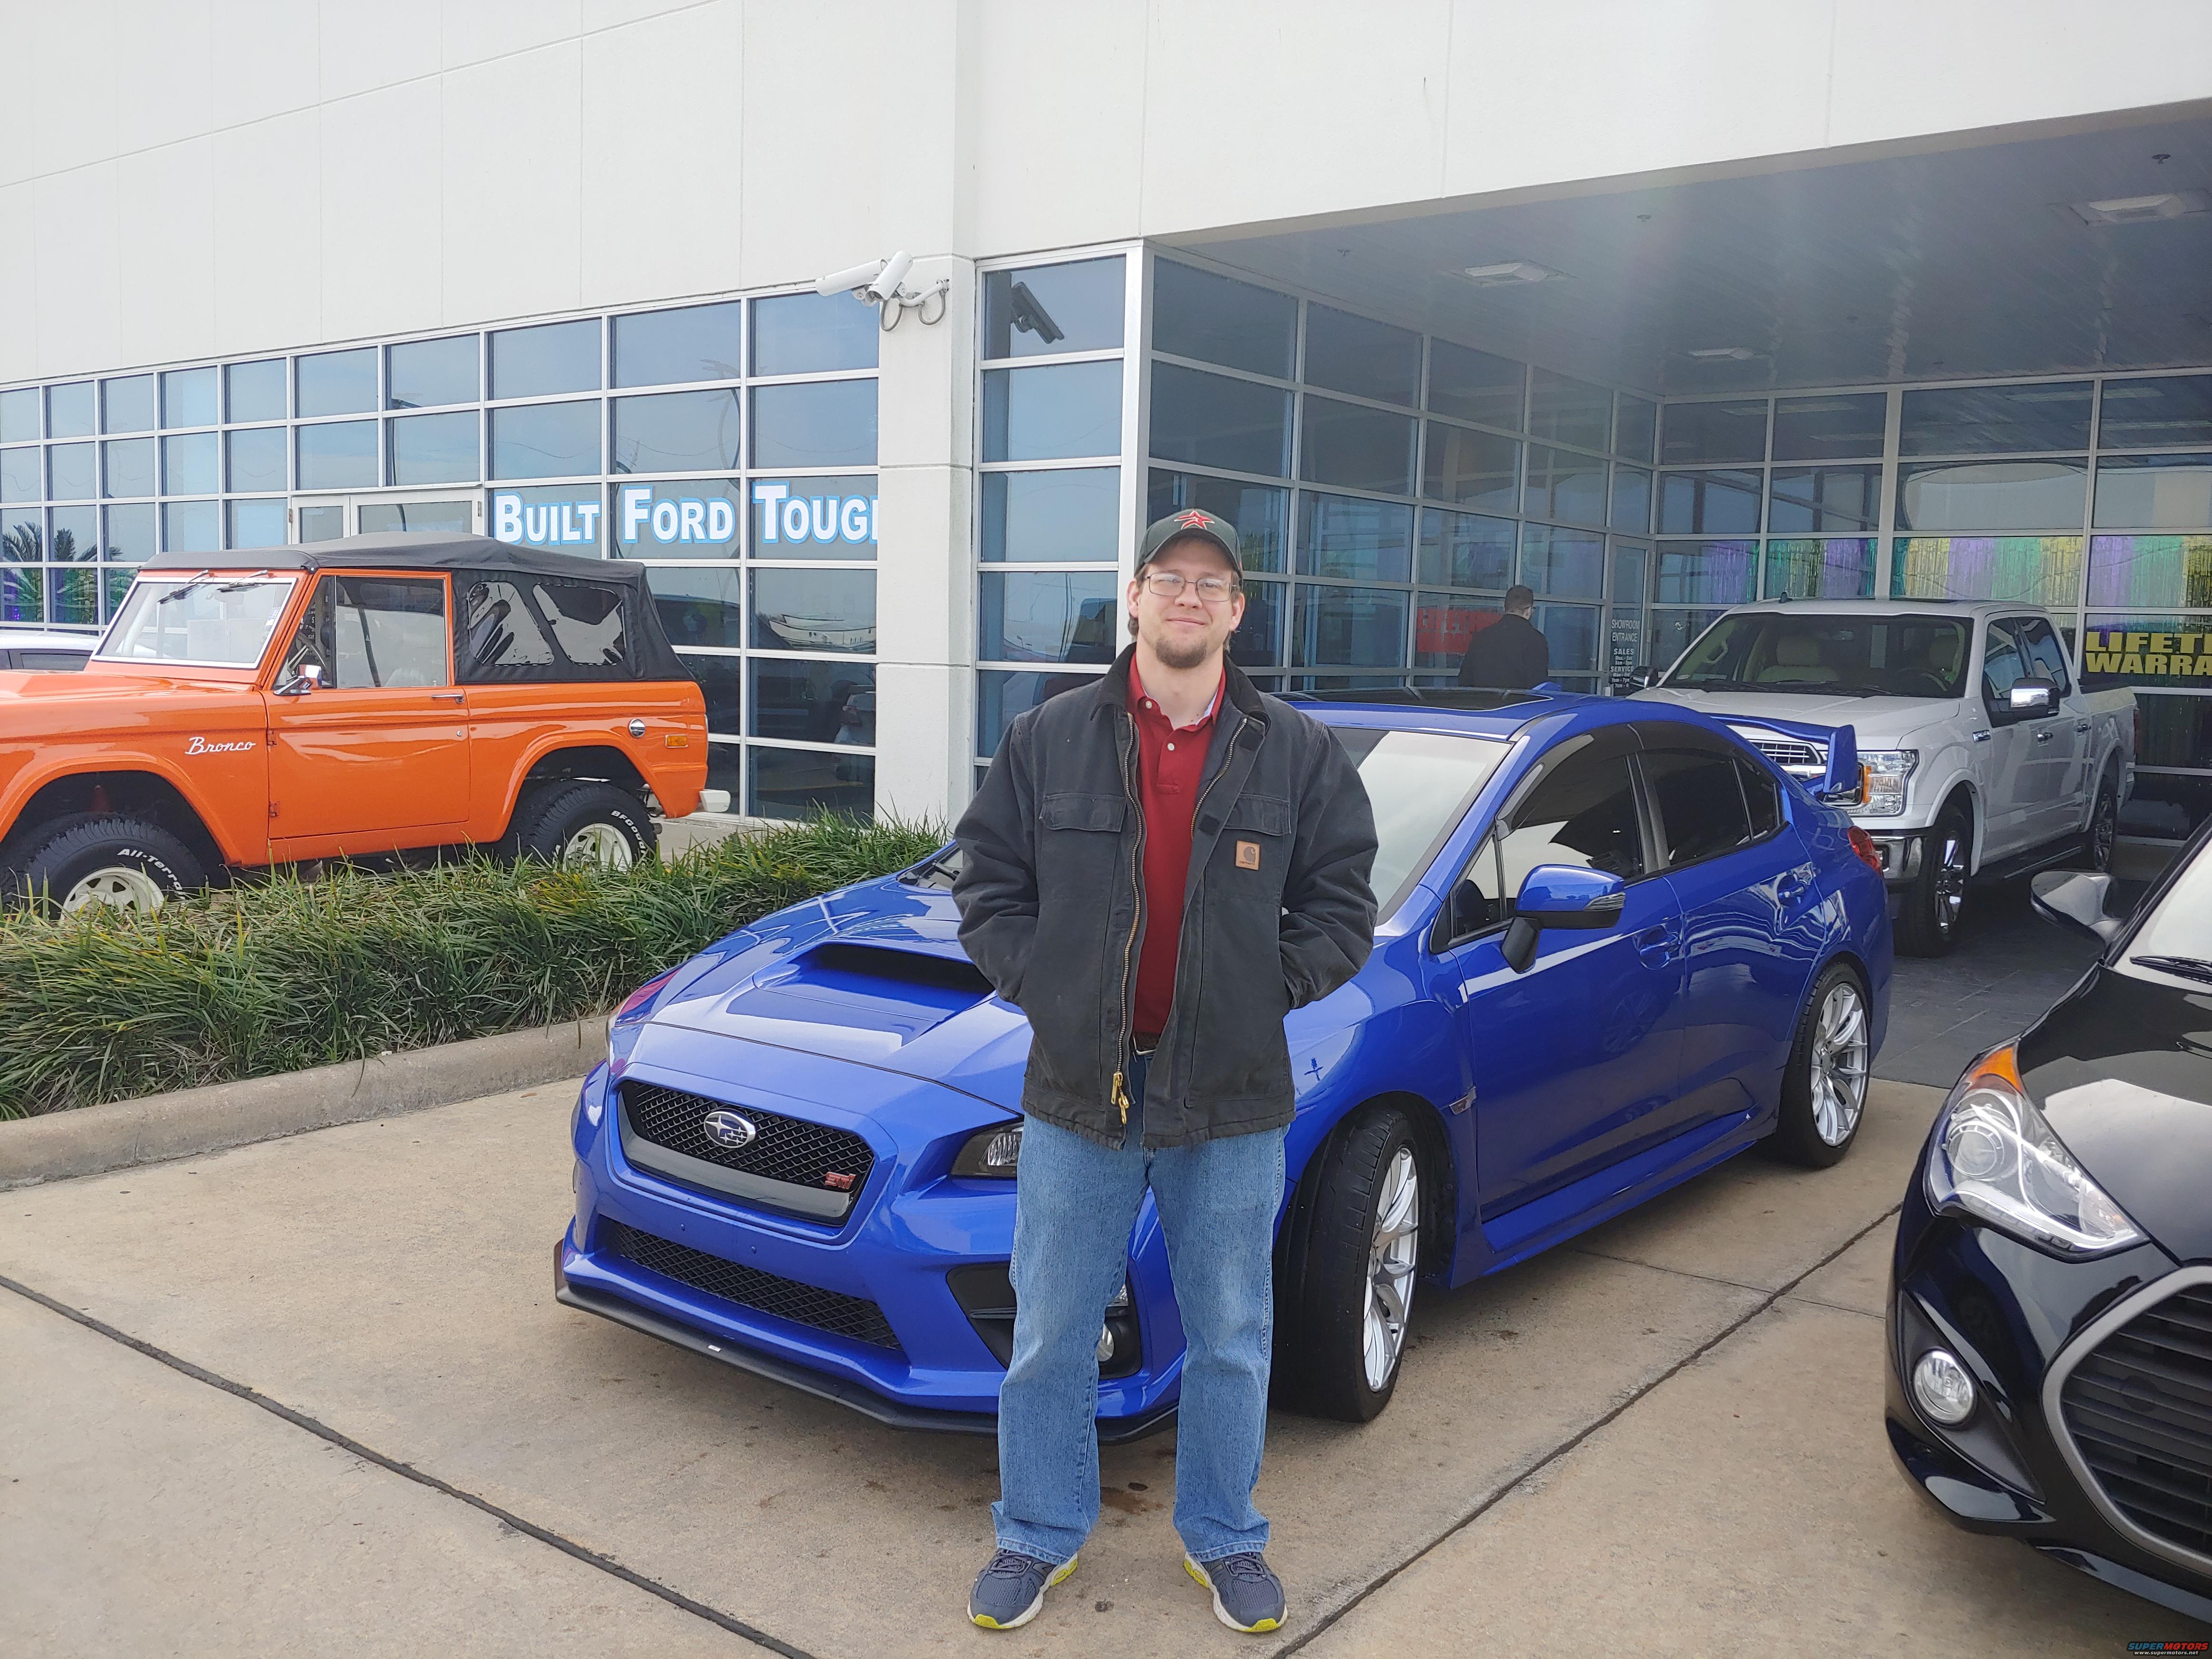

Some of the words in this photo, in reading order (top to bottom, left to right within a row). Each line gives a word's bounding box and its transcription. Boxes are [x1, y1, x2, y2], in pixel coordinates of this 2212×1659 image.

[494, 491, 601, 546] BUILT
[622, 485, 736, 544] FORD
[1611, 619, 1640, 629] SHOWROOM
[1612, 632, 1638, 642] ENTRANCE
[2086, 653, 2212, 676] WARRA
[184, 736, 256, 754] Bronco
[611, 810, 647, 858] BFGoodr
